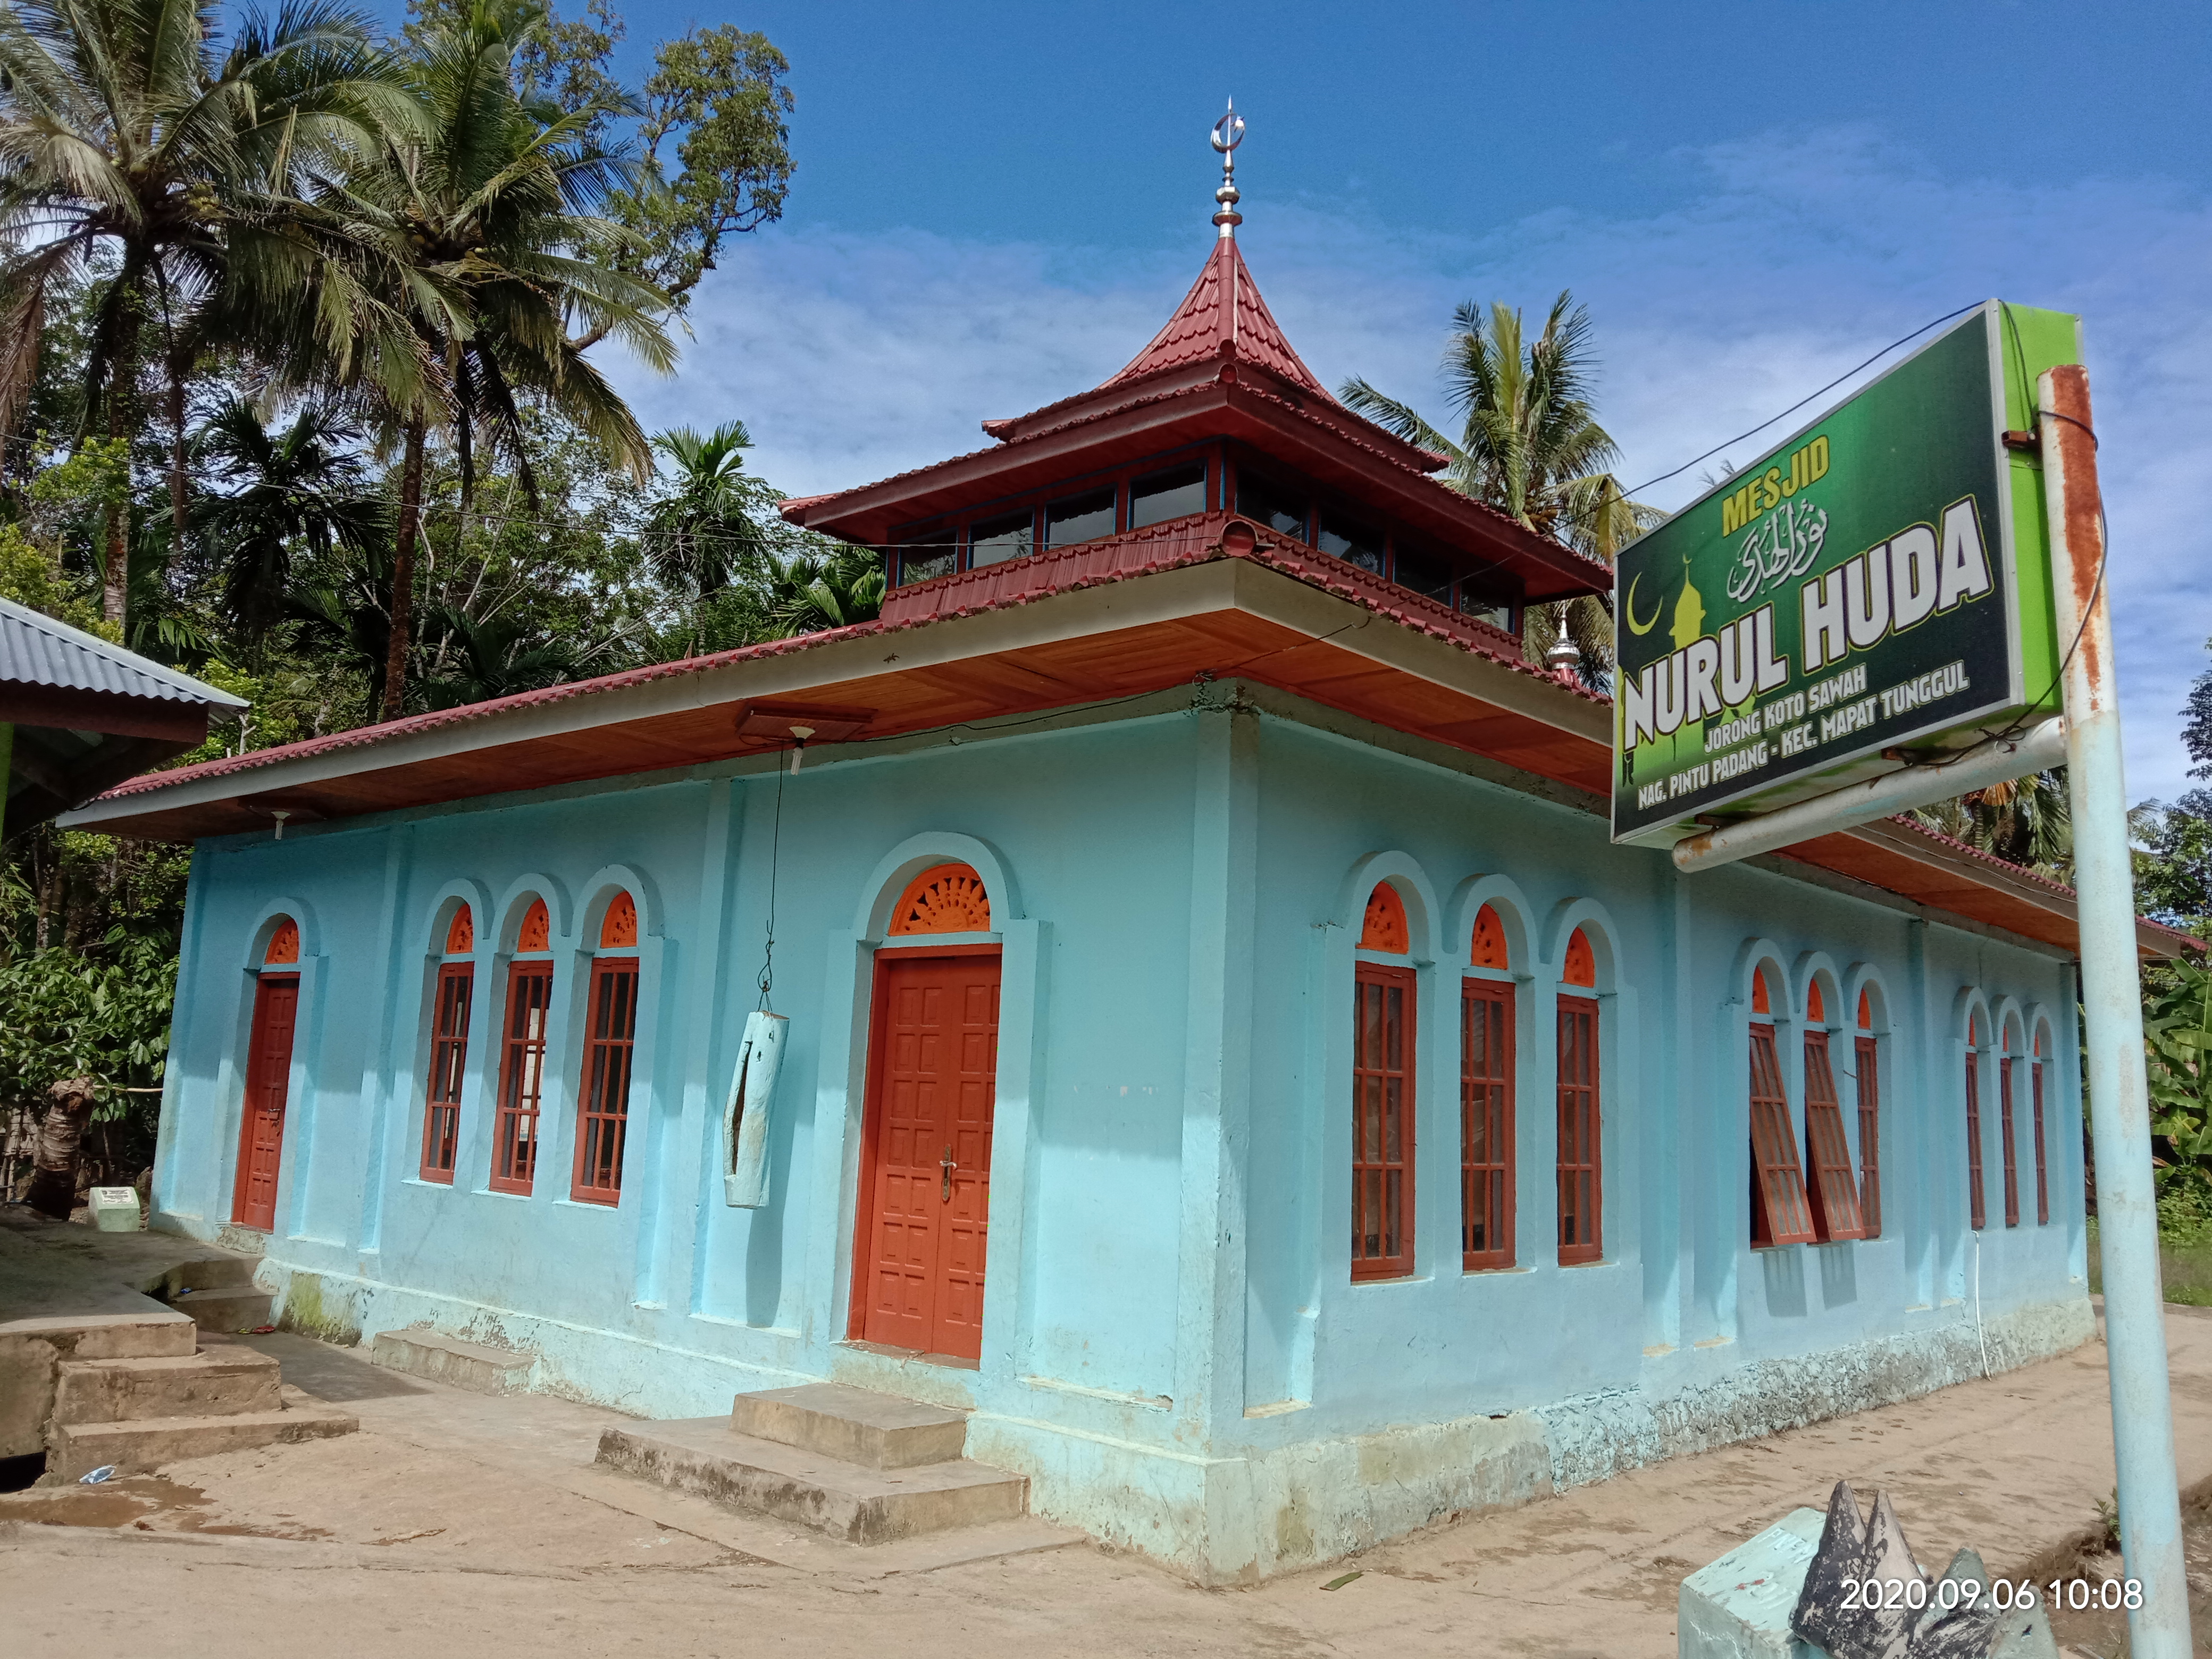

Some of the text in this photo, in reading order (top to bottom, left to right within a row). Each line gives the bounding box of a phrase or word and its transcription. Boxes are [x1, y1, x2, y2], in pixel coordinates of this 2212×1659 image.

[1722, 434, 1830, 538] MESJID
[1623, 494, 1993, 752] NURUL HUDA
[1638, 780, 1667, 810] NAG.
[1670, 762, 1710, 799] PINTU
[1712, 739, 1769, 784] PADANG
[1782, 721, 1819, 758] KEC.
[1821, 694, 1878, 743] MAPAT
[1880, 659, 1970, 718] TUNGGUL
[1704, 663, 1867, 753] JORONG KOTO SAWAH
